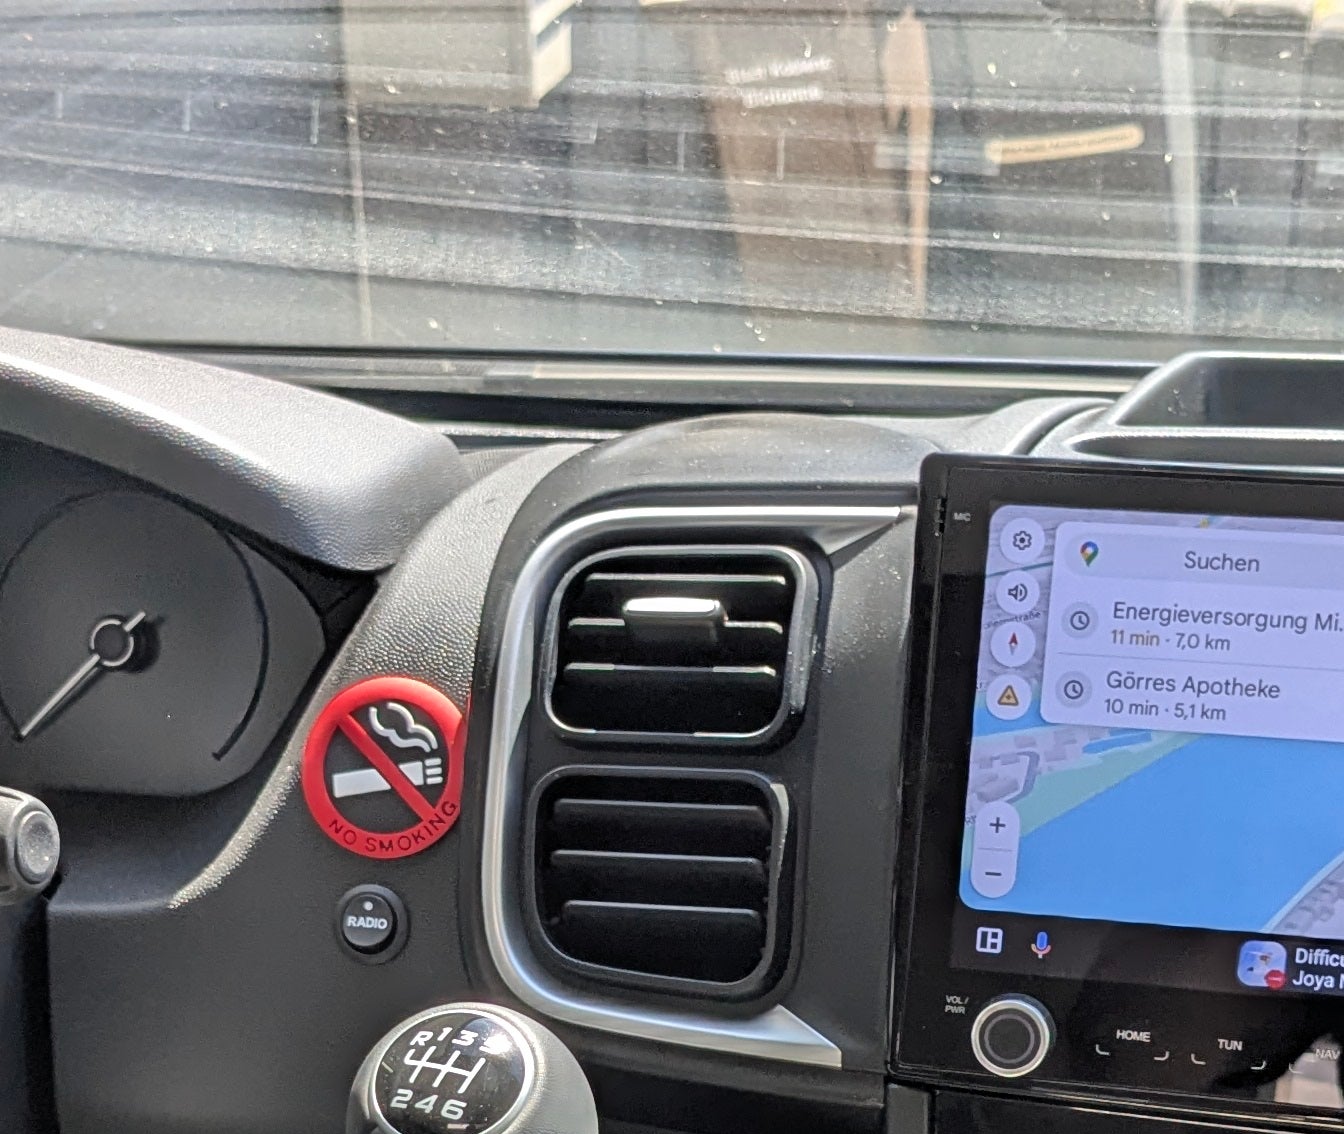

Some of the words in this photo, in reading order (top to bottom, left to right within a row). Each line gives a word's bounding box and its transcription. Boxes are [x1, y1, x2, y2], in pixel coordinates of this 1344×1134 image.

[1184, 551, 1260, 573] Suchen
[1113, 601, 1308, 634] Energieversorgung
[1111, 630, 1125, 645] 11
[1129, 631, 1160, 647] min
[1175, 633, 1200, 650] 7,0
[1205, 634, 1231, 651] km
[1106, 670, 1177, 693] Görres
[1182, 675, 1281, 698] Apotheke
[1104, 699, 1124, 715] 10
[1129, 700, 1159, 716] min
[1174, 703, 1196, 720] 5,1
[1202, 704, 1227, 721] km
[329, 820, 357, 845] NO
[365, 801, 458, 852] SMOKING
[347, 916, 388, 930] RADIO
[1292, 971, 1334, 992] Joya
[944, 1004, 966, 1015] PWR
[410, 1031, 433, 1046] R
[437, 1027, 452, 1041] 1
[452, 1030, 478, 1046] 3
[1116, 1029, 1151, 1043] HOME
[1217, 1038, 1243, 1051] TUN
[1315, 1049, 1341, 1061] NAV
[390, 1088, 413, 1108] 2
[415, 1095, 438, 1113] 4
[441, 1099, 467, 1120] 6
